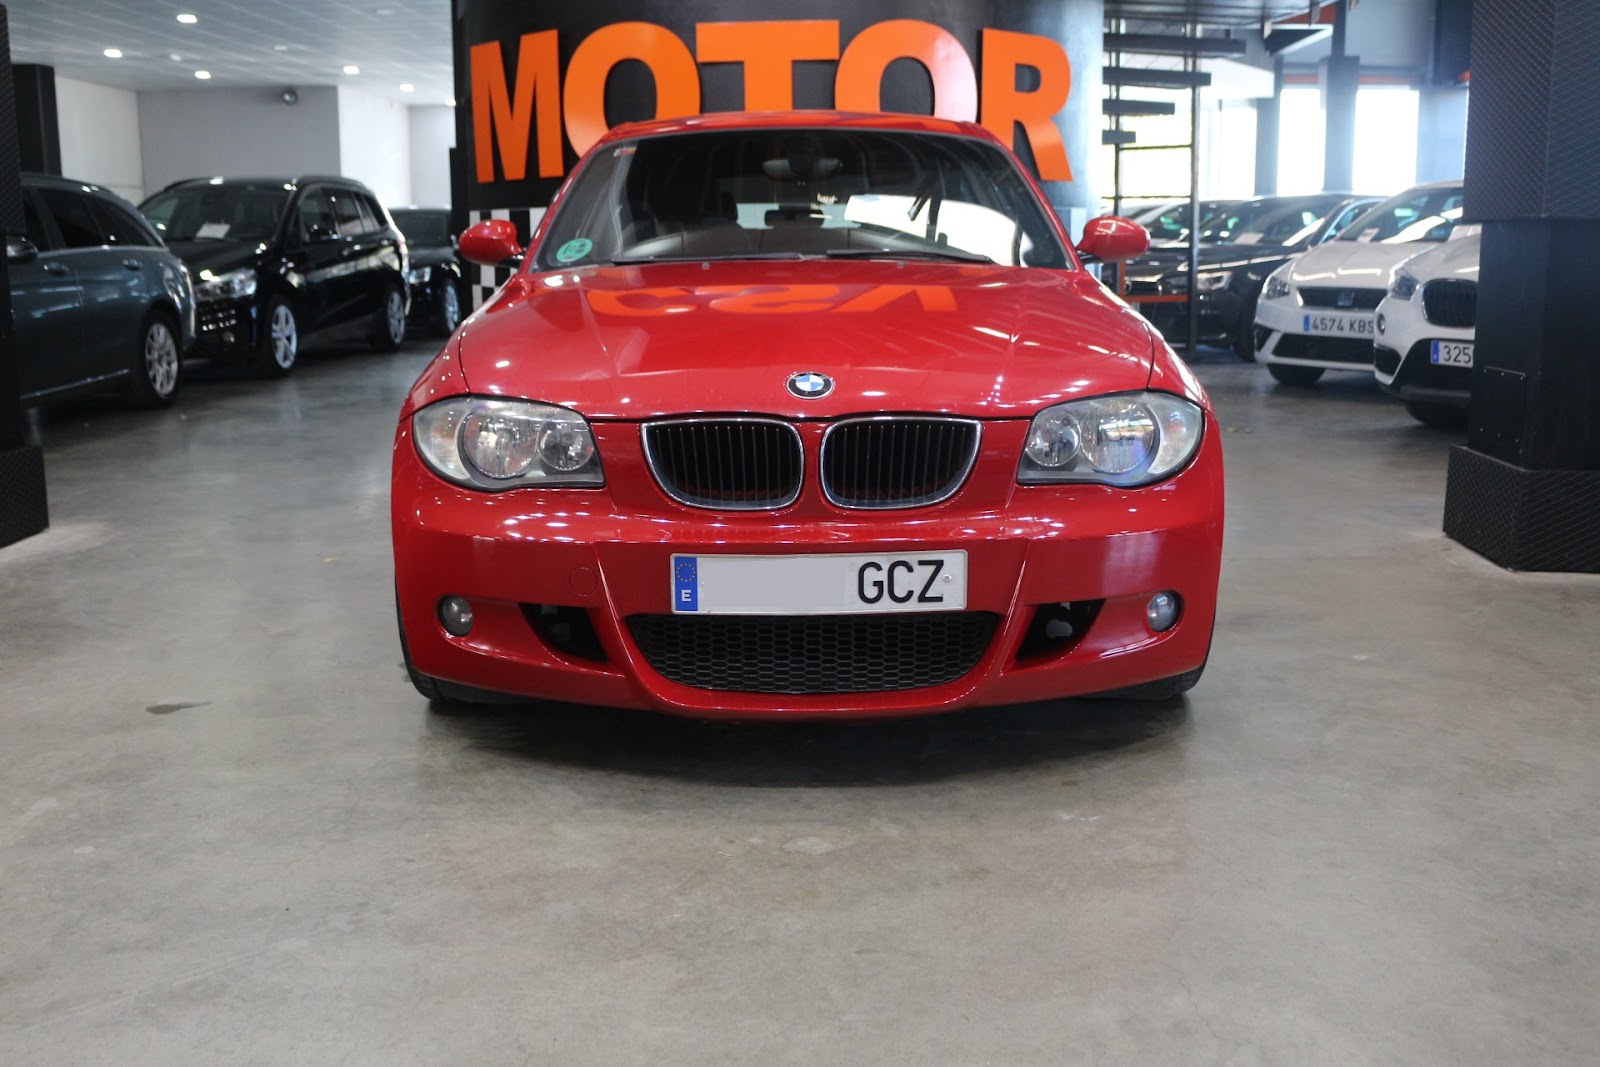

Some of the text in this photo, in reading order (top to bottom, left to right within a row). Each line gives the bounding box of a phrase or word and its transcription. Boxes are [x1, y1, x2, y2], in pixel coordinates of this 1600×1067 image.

[470, 20, 1073, 183] MOTOR
[1312, 317, 1374, 334] 4574 KBS
[1443, 345, 1472, 364] 325
[858, 560, 944, 604] GCZ
[681, 590, 692, 602] E
